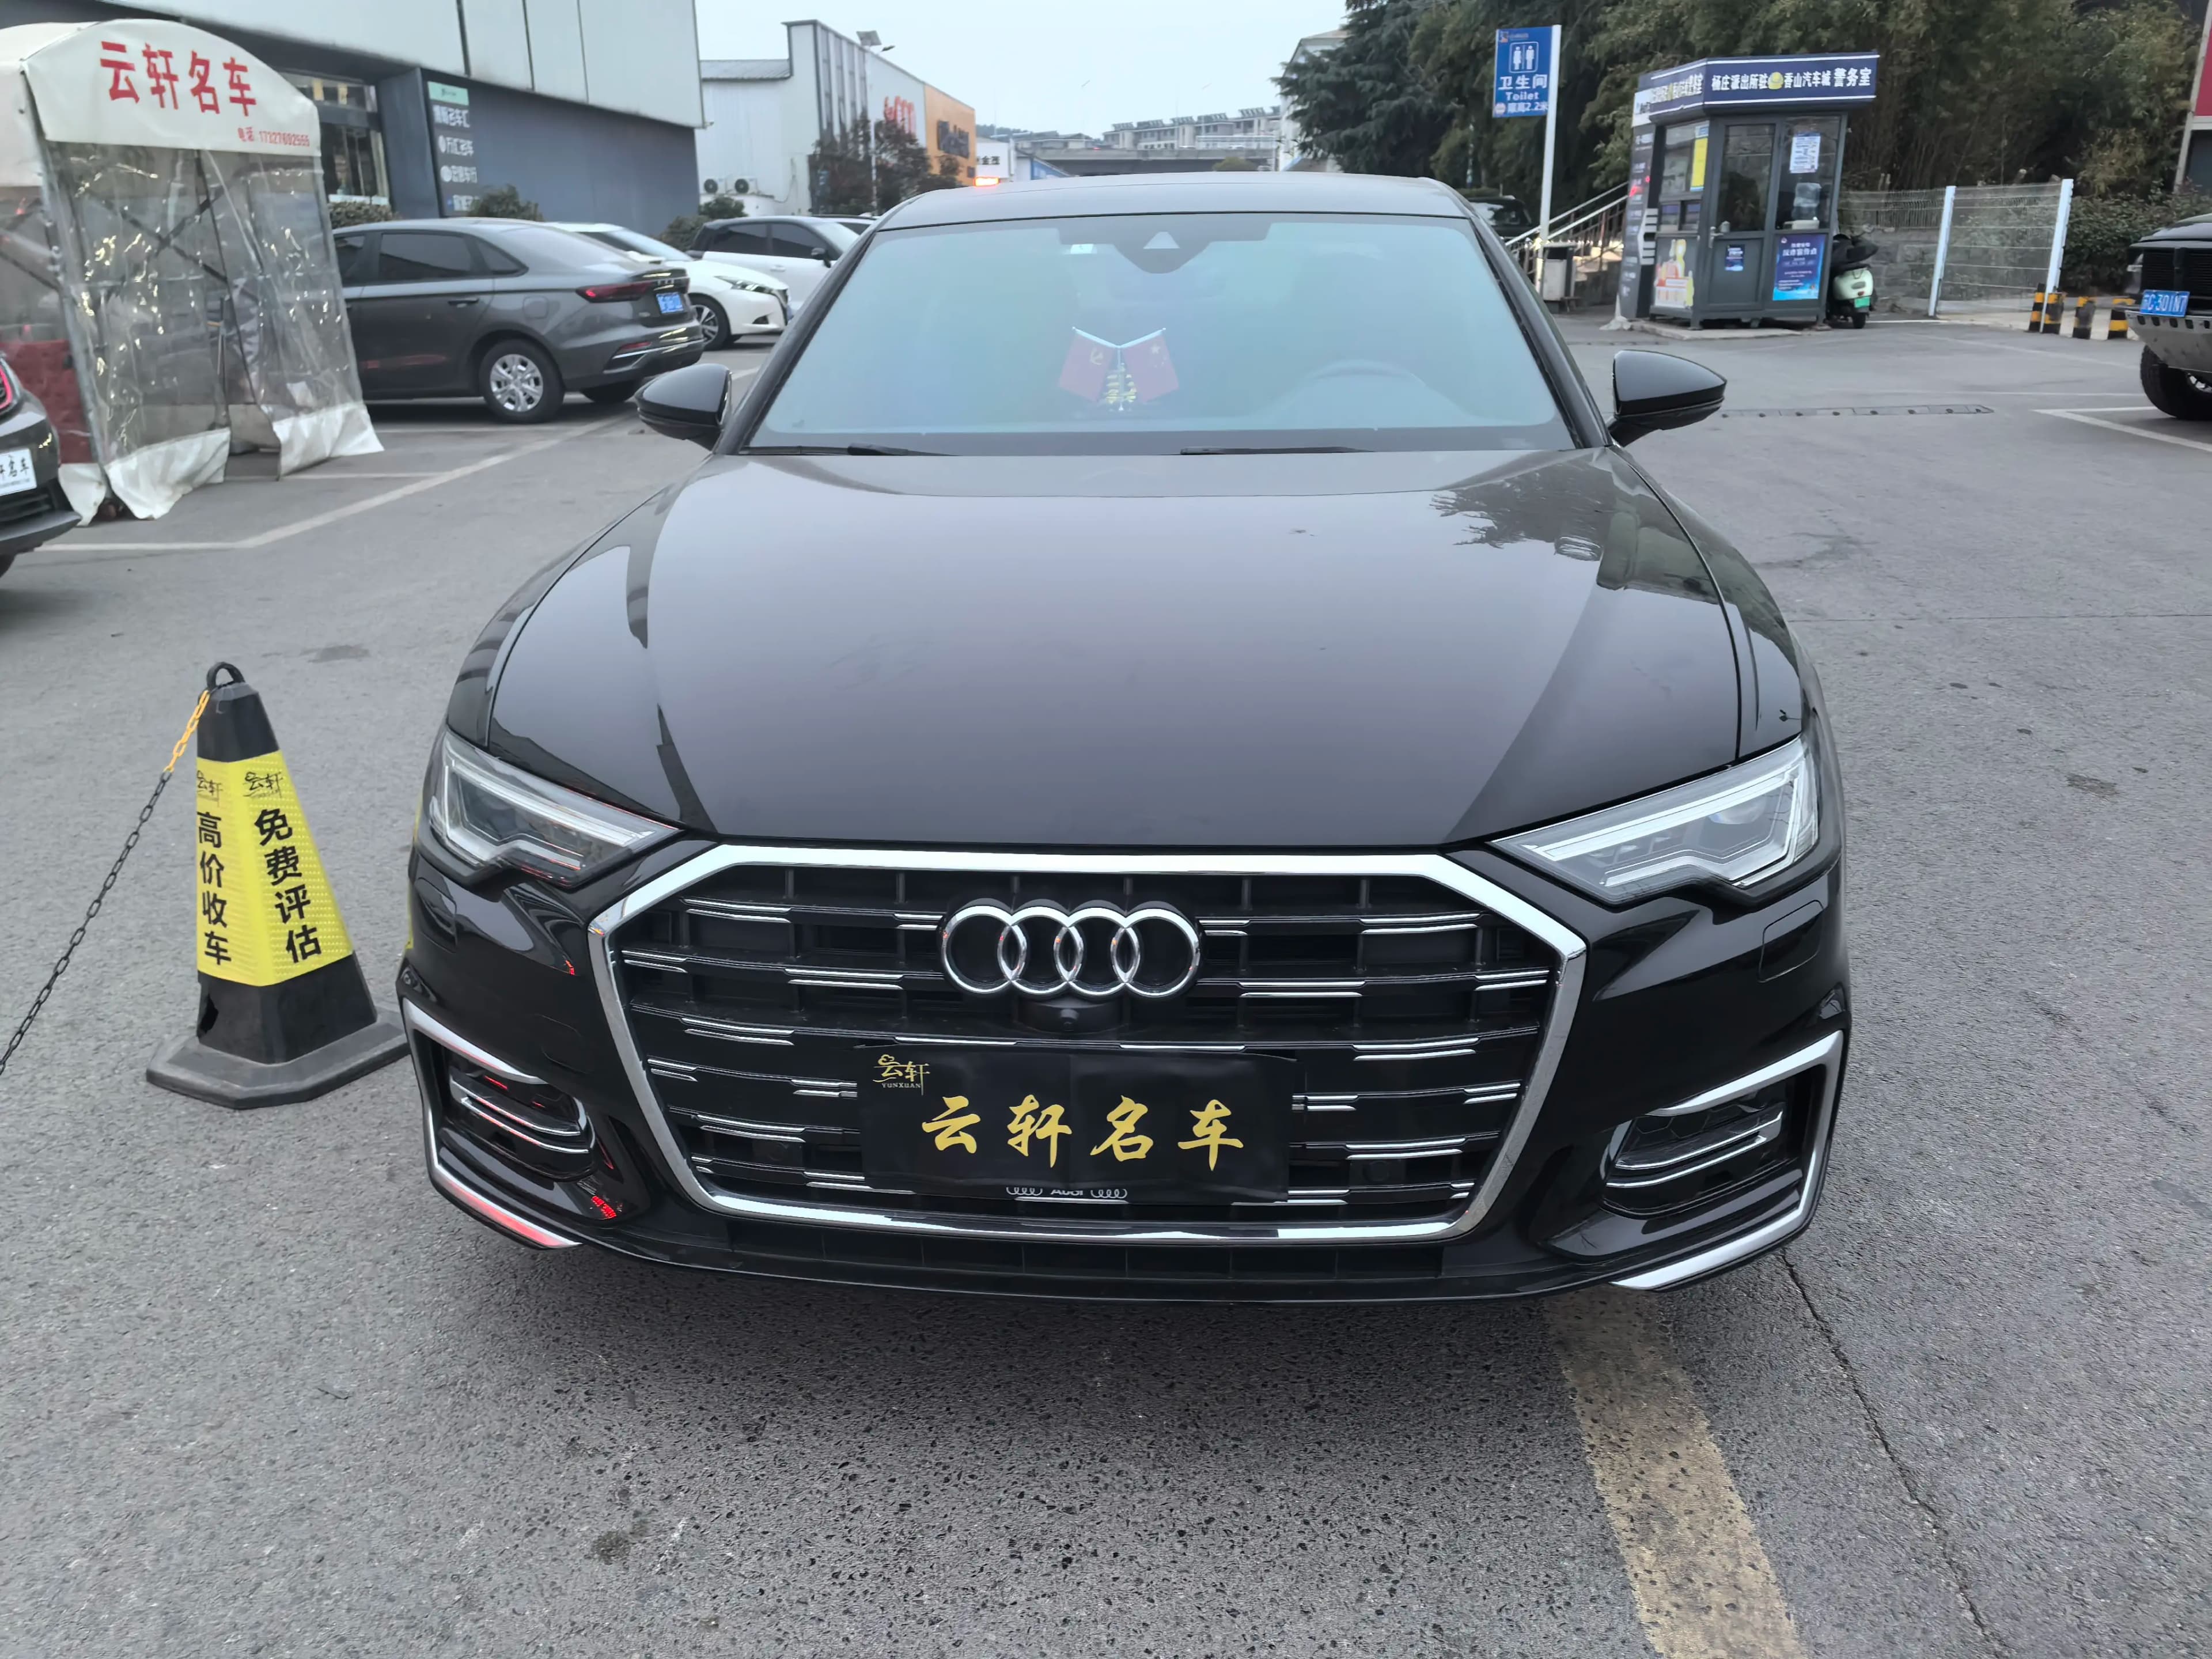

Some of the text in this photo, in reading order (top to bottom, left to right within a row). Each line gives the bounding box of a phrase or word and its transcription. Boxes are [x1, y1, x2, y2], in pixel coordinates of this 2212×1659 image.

[100, 40, 257, 117] 云轩名车
[1498, 74, 1548, 90] 卫生间
[1506, 91, 1539, 101] Toilet
[1834, 67, 1872, 87] 警务室
[196, 811, 232, 965] 高价收车
[253, 808, 322, 963] 免费评估
[922, 1094, 1244, 1171] 云轩名车
